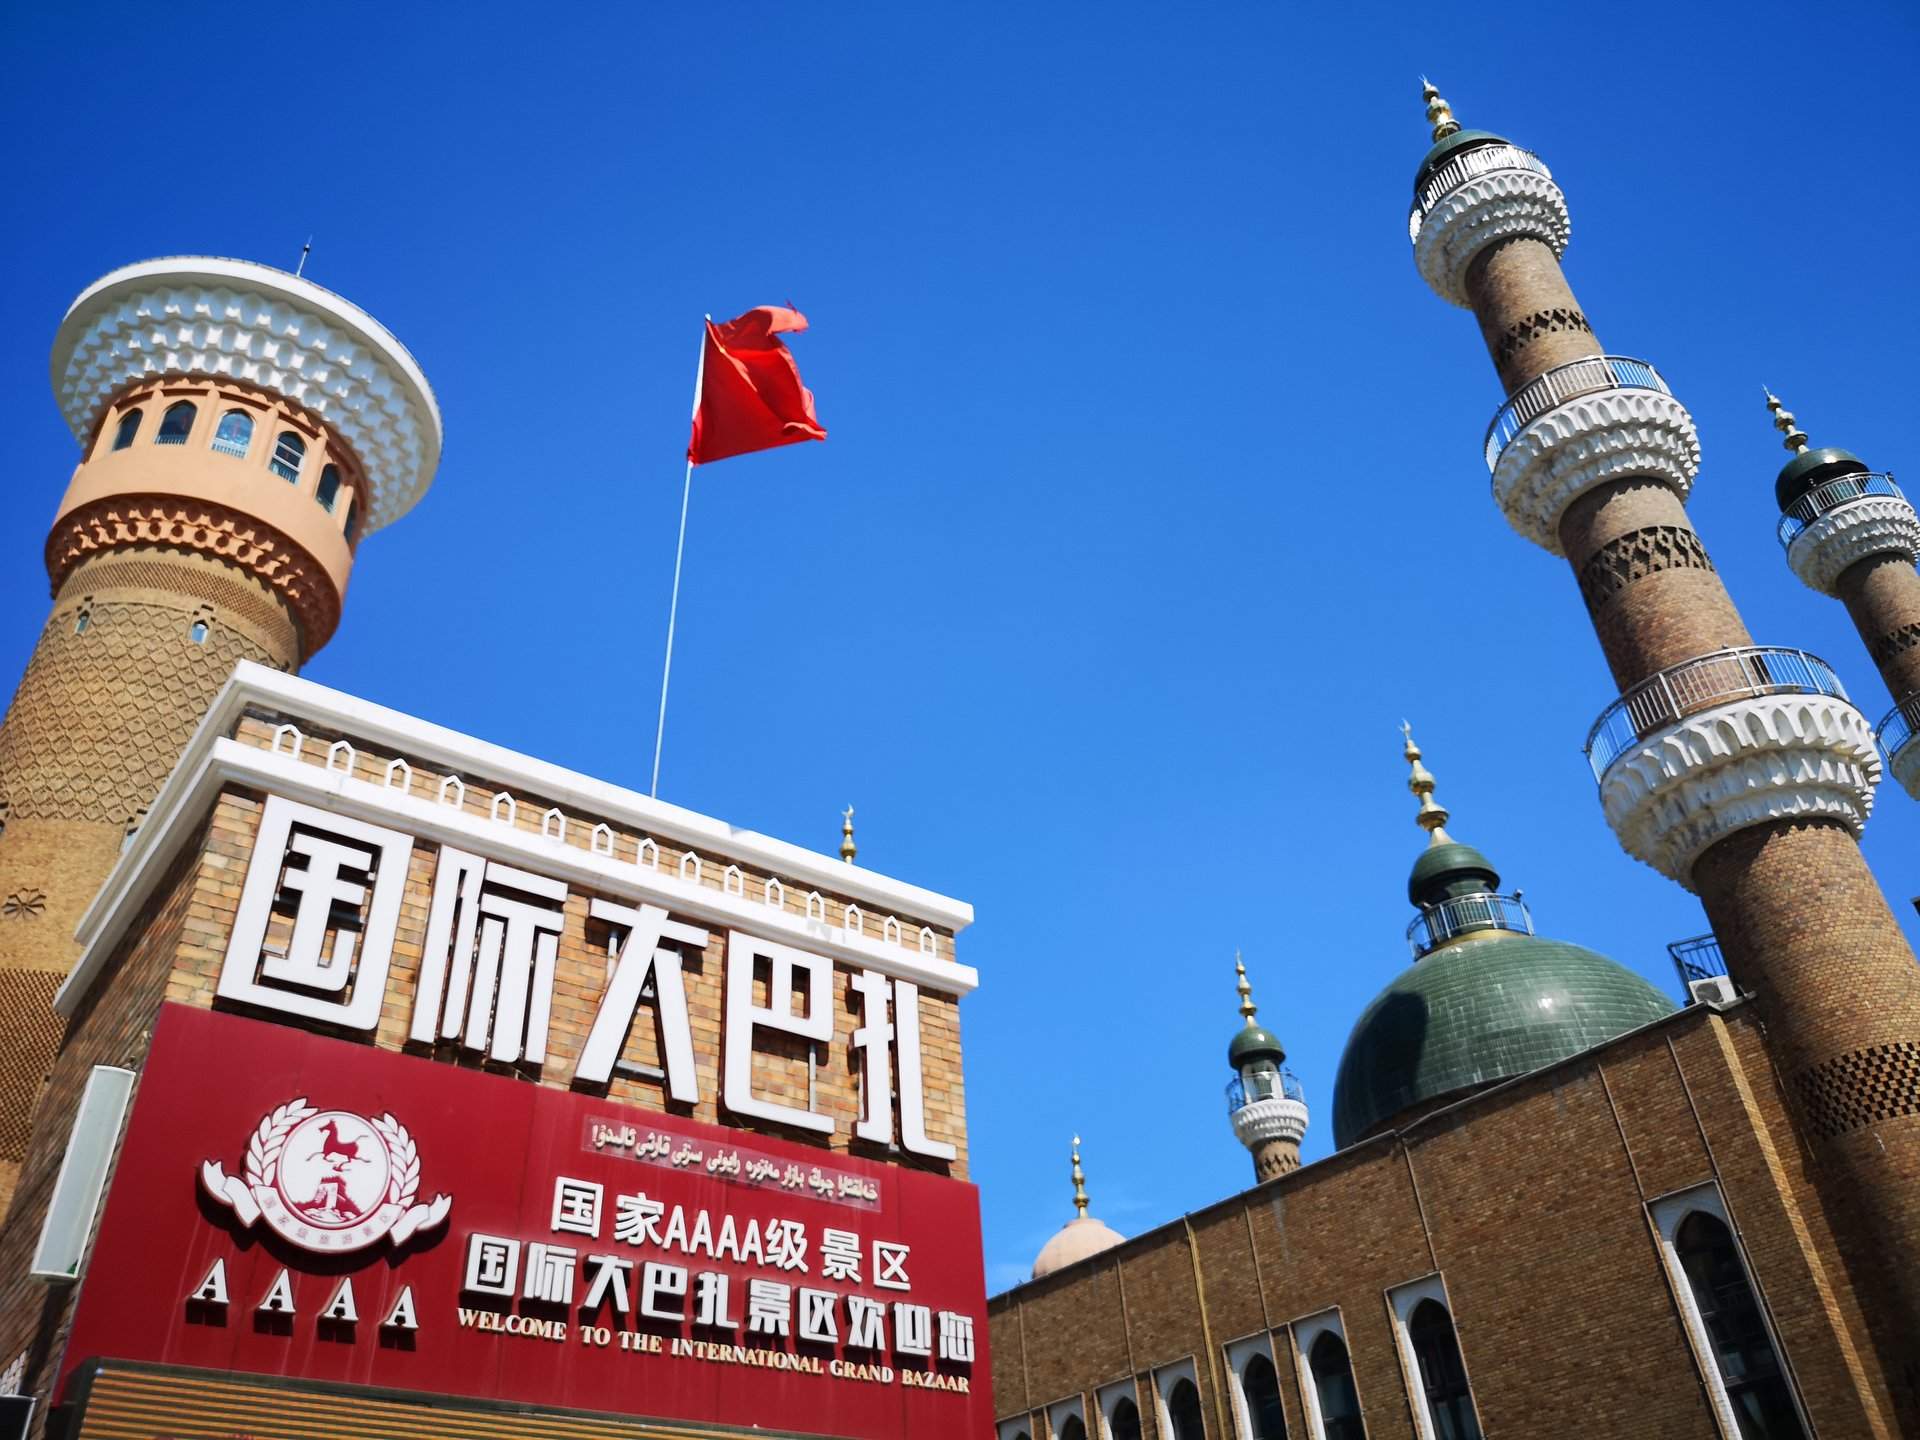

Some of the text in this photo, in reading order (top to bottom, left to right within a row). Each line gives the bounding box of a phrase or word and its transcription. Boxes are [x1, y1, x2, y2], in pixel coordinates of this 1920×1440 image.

[217, 793, 957, 1161] 国际大巴扎
[457, 1307, 970, 1394] WELCOME TO THE INTERNATIONAL GRAND BAZAAR
[464, 1233, 975, 1363] 国际大巴扎景区欢迎您
